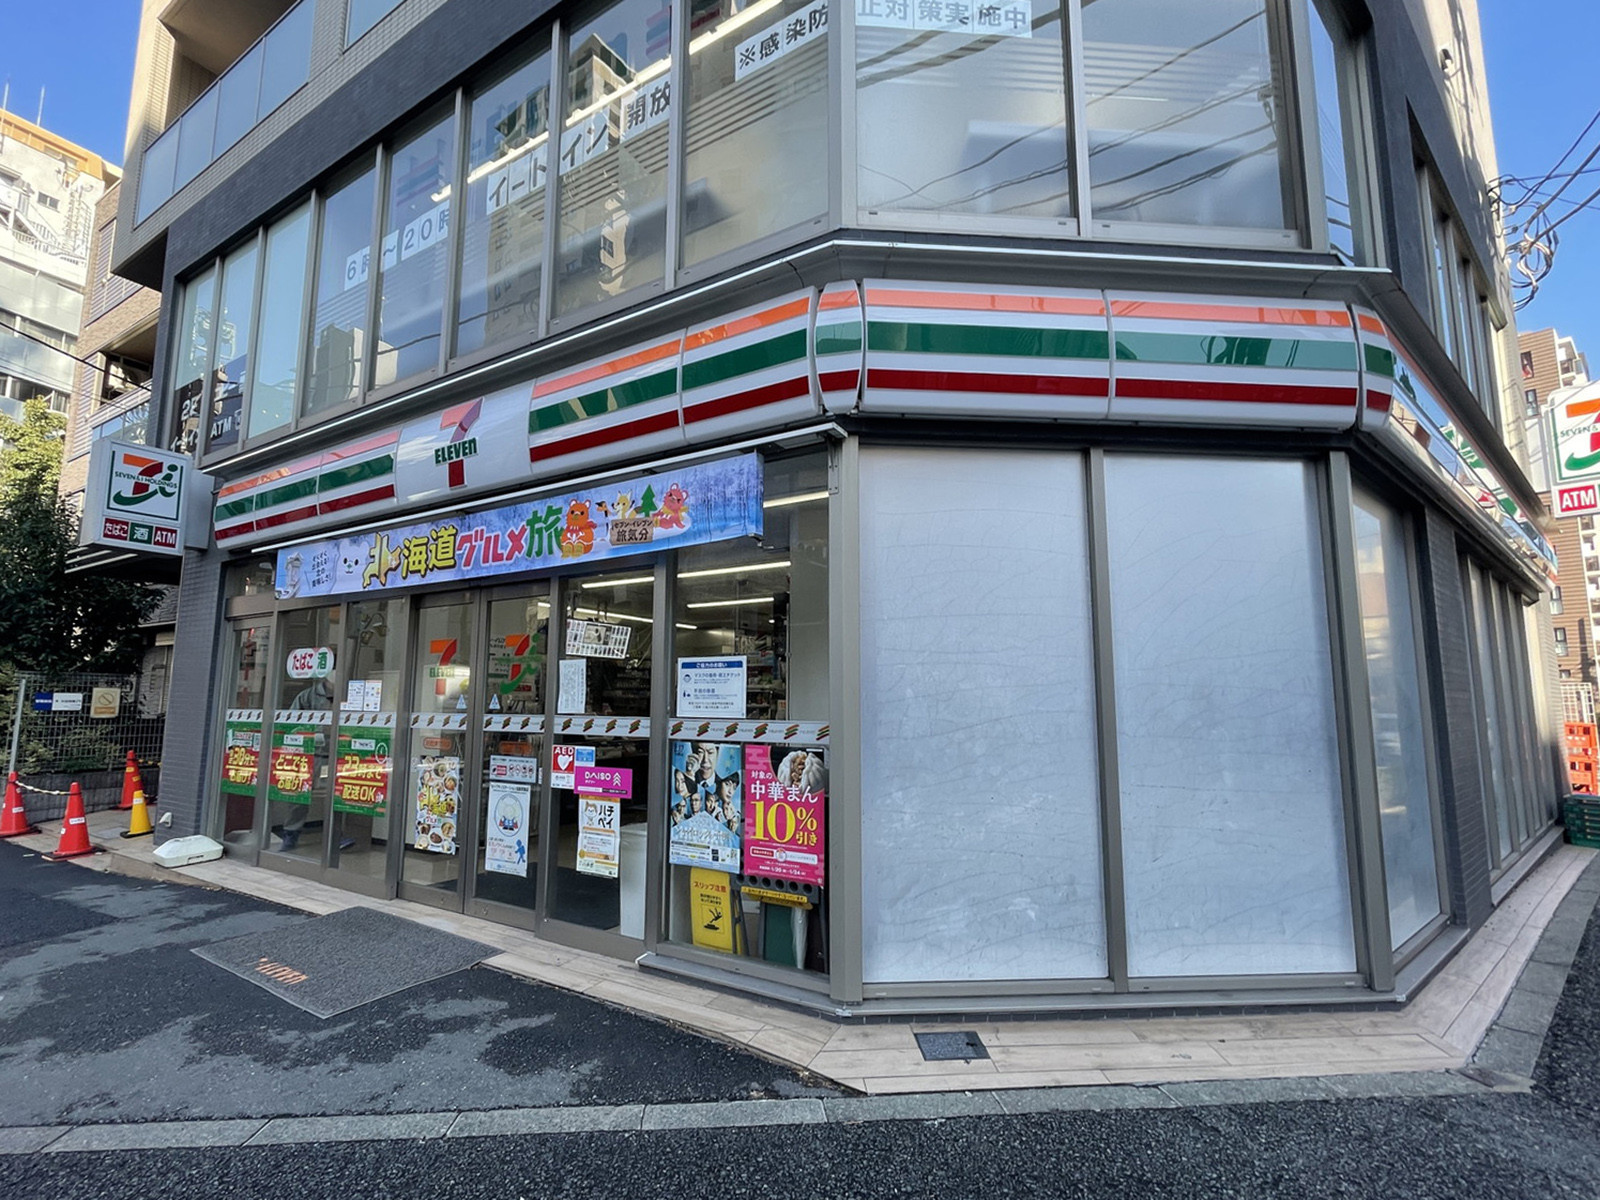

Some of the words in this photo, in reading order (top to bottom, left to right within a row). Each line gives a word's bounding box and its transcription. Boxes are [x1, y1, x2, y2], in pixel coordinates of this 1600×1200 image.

[210, 416, 233, 439] ATM
[1561, 488, 1596, 510] ATM
[104, 522, 129, 538] たばこ
[133, 526, 150, 541] 酒
[154, 530, 177, 545] ATM
[617, 528, 650, 542] 旅気分
[291, 652, 314, 671] たばこ
[317, 651, 328, 670] 酒
[554, 747, 574, 755] AED
[275, 754, 308, 773] どこでも
[584, 771, 612, 781] DAISO
[751, 770, 773, 780] 対象の
[341, 784, 377, 802] 配送OK
[750, 780, 819, 804] 中華まん
[795, 832, 818, 847] 引き
[694, 881, 727, 893] スリップ注意
